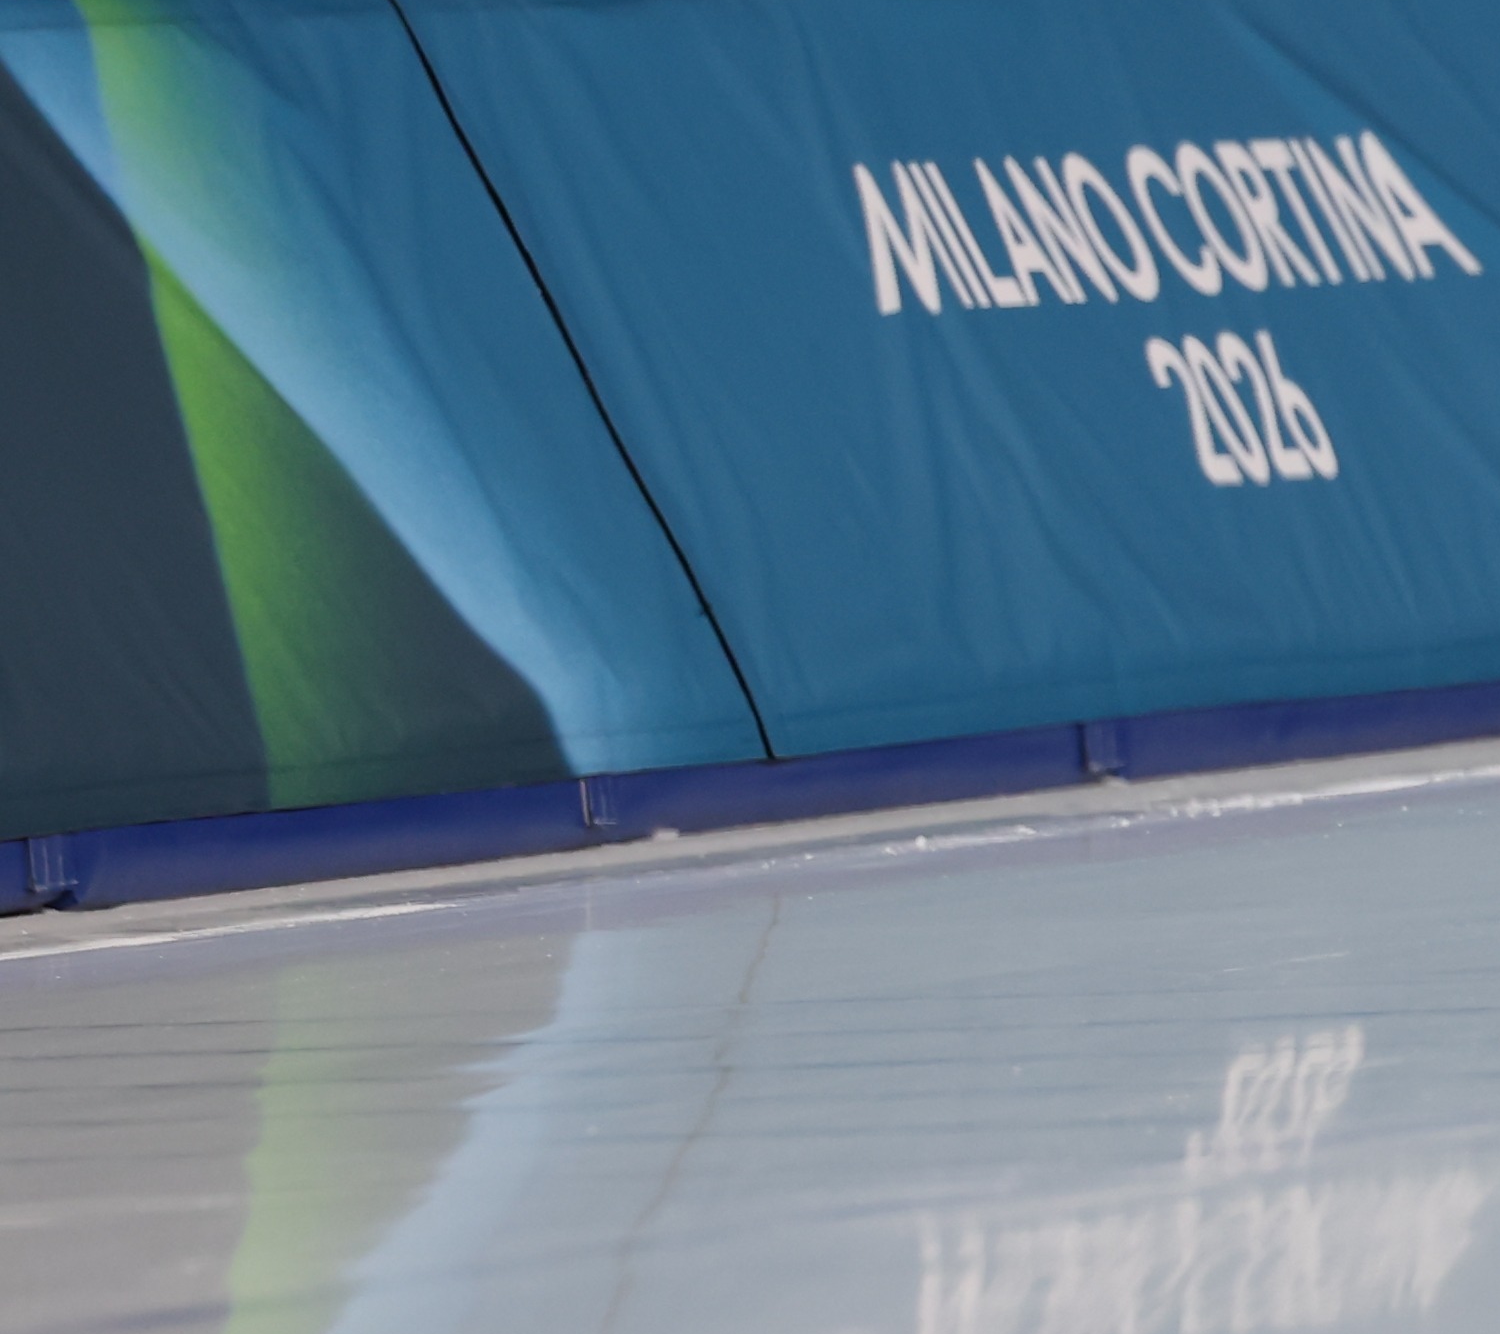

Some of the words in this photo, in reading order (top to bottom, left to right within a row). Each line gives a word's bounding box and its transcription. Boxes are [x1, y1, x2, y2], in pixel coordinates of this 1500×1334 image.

[853, 152, 1160, 315] MILANO
[1127, 130, 1482, 296] CORTINA
[1145, 330, 1338, 485] 2026
